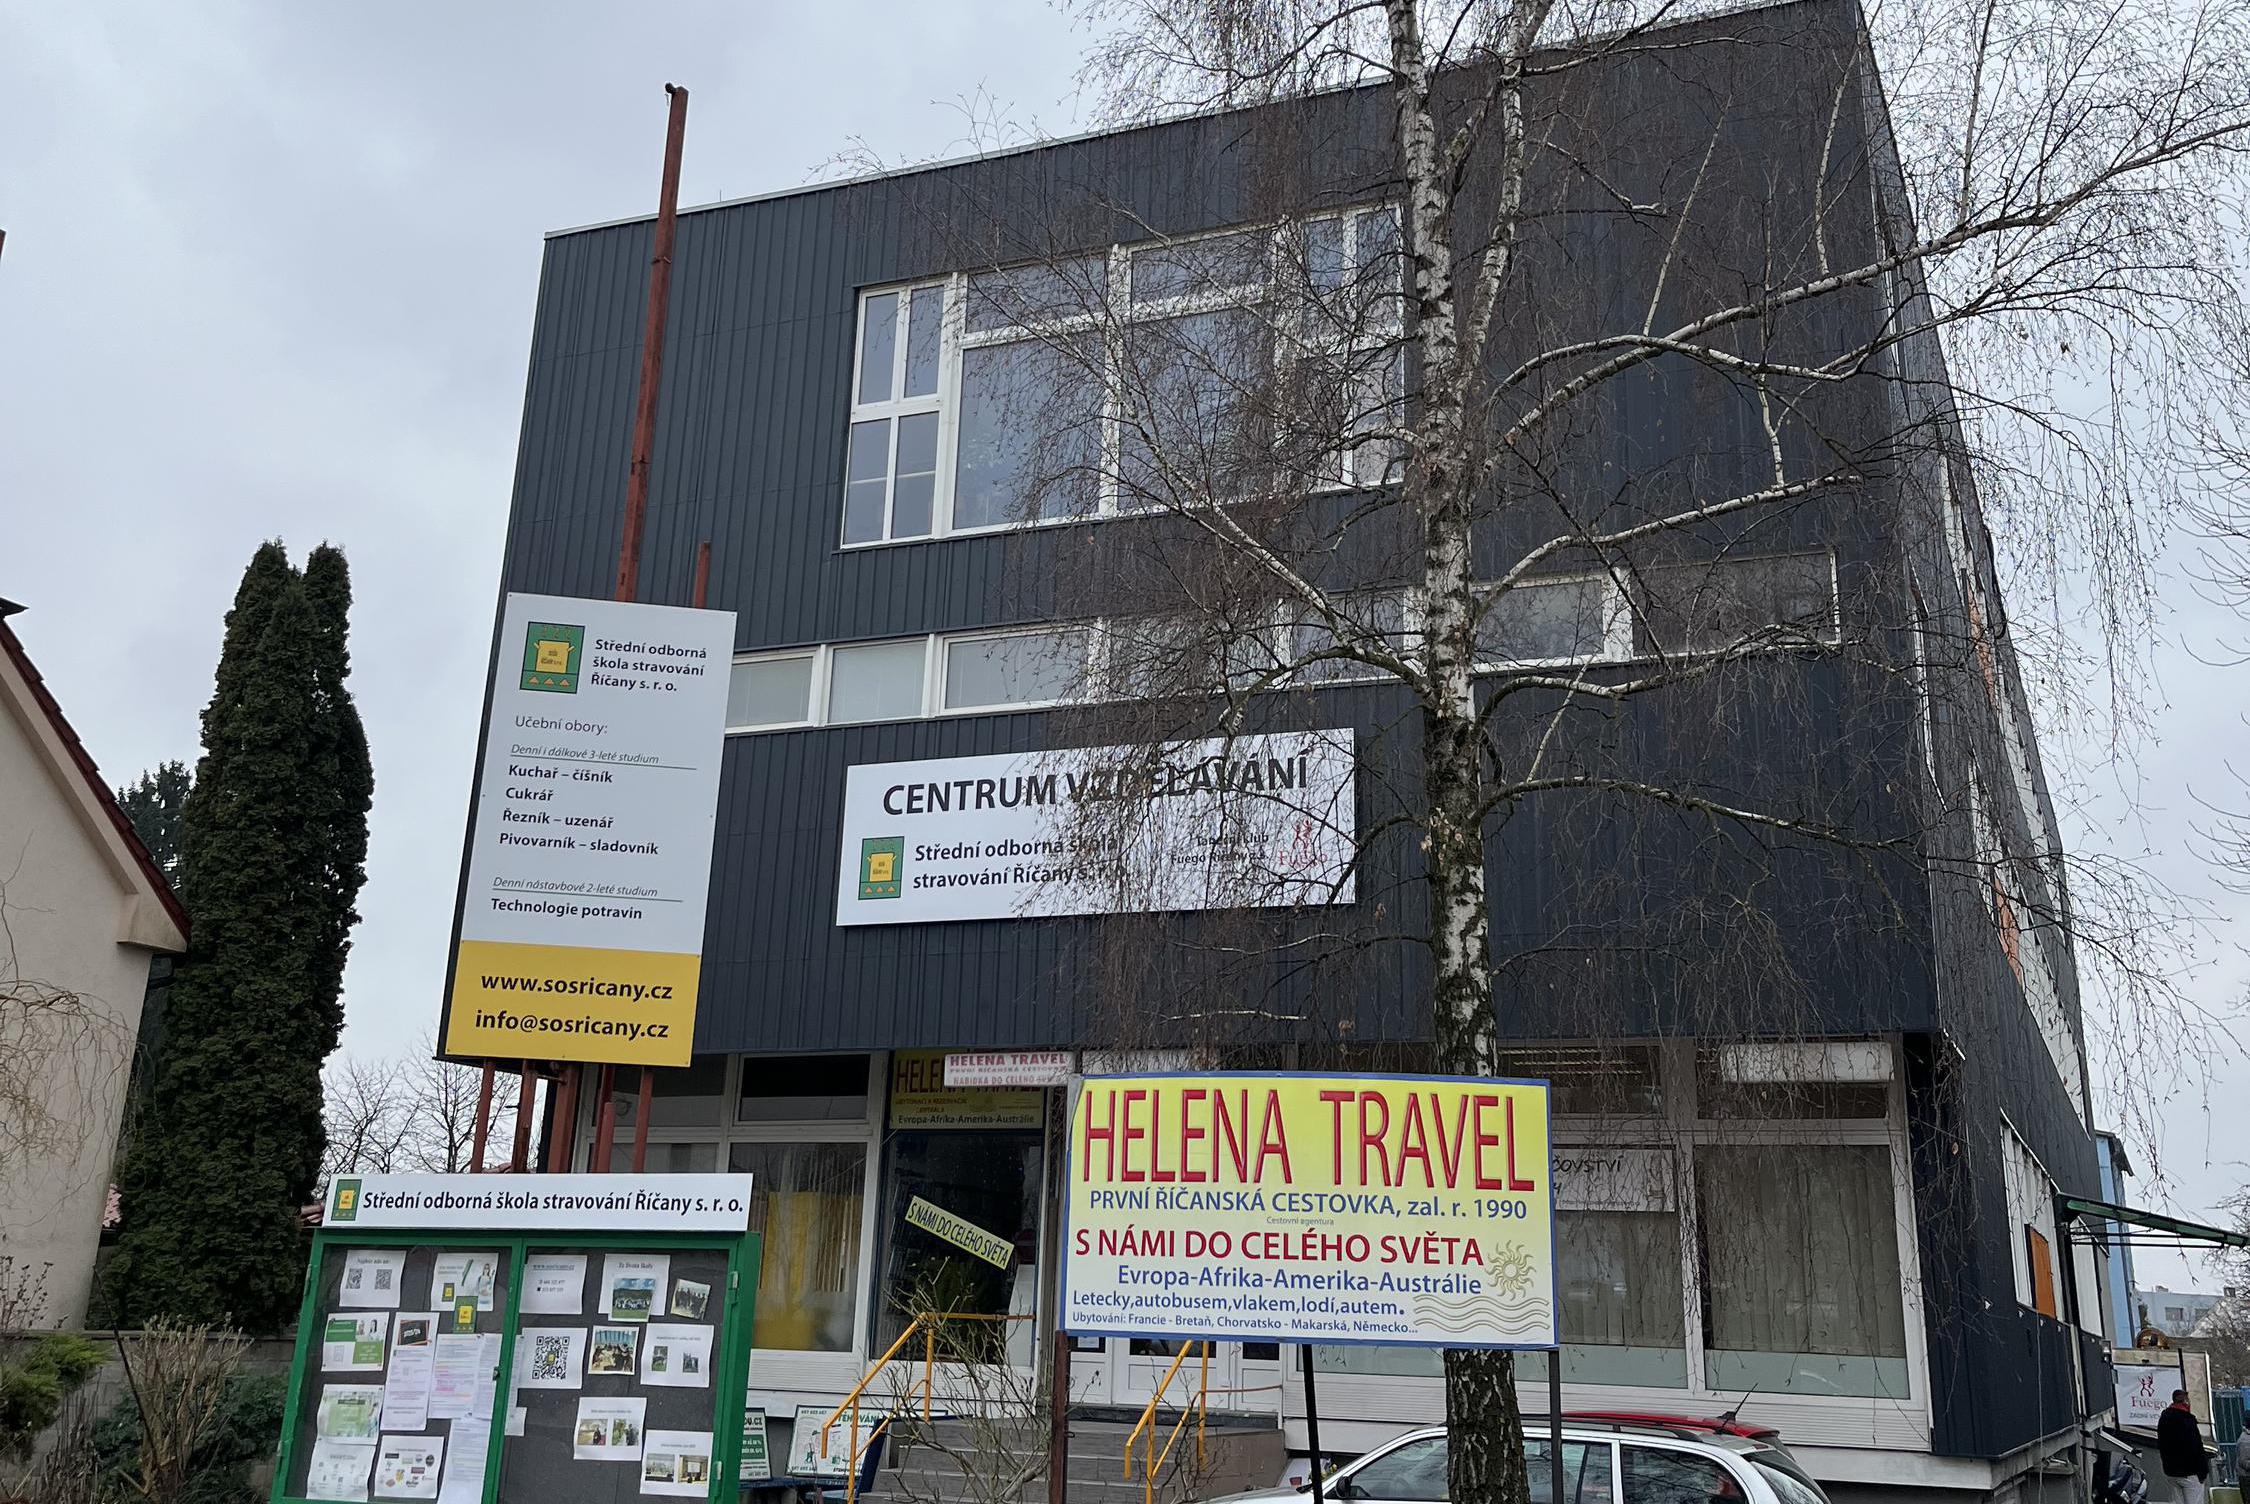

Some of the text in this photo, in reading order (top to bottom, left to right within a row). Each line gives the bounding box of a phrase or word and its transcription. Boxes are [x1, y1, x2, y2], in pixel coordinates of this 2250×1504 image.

[595, 639, 707, 659] Střední odborná
[593, 657, 705, 676] škola stravování
[591, 674, 677, 691] Říčany s. r. o.
[516, 716, 608, 736] Učební obory:
[512, 744, 543, 755] Denní
[548, 747, 588, 758] dálkové
[590, 750, 617, 760] 3-leté
[619, 753, 659, 764] studium
[509, 764, 558, 779] Kuchař
[573, 769, 613, 783] číšník
[505, 787, 553, 801] Cukrář
[883, 774, 1056, 815] CENTRUM
[503, 808, 550, 824] Řezník
[565, 816, 614, 828] uzenář
[500, 832, 576, 849] Pivovarník
[590, 839, 659, 854] sladovník
[915, 841, 980, 861] Střední
[985, 836, 1063, 857] odborná
[1171, 854, 1205, 866] Fuego
[913, 867, 1008, 889] stravování
[1013, 863, 1073, 886] Říčany
[493, 877, 658, 897] Denní nástavbové 2-leté studium
[491, 899, 642, 919] Technologie potravin
[481, 975, 673, 1002] www.sosricany.cz
[475, 1009, 669, 1041] info@sosricany.cz
[951, 1053, 1066, 1067] HELENA TRAVEL
[1083, 1088, 1535, 1192] HELENA TRAVEL
[363, 1191, 421, 1209] Střední
[424, 1191, 492, 1209] odborná
[496, 1192, 538, 1209] škola
[543, 1192, 633, 1209] stravování
[635, 1189, 692, 1215] Říčany
[695, 1198, 708, 1211] s.
[713, 1198, 723, 1211] r.
[729, 1198, 743, 1212] o.
[1090, 1186, 1527, 1219] PRVNÍ ŘÍČANSKÁ CESTOVKA, zal. r. 1990
[1266, 1216, 1334, 1226] Cestovní agentura
[908, 1203, 1009, 1266] S NÁMI DO CELÉHO SVĚTA
[1075, 1224, 1484, 1266] S NÁMI DO CELÉHO SVĚTA
[1118, 1265, 1481, 1295] Evropa-Afrika-Amerika-Austrálie
[1073, 1290, 1405, 1316] Letecky,autobusem,vlakem,lodí,autem.
[1072, 1311, 1126, 1324] Ubytování:
[1128, 1313, 1166, 1325] Francie
[1176, 1315, 1214, 1327] Bretaň,
[1217, 1316, 1281, 1329] Chorvatsko
[1292, 1319, 1350, 1332] Makarská,
[1354, 1320, 1418, 1334] Německo...
[2132, 1396, 2167, 1409] Fuego
